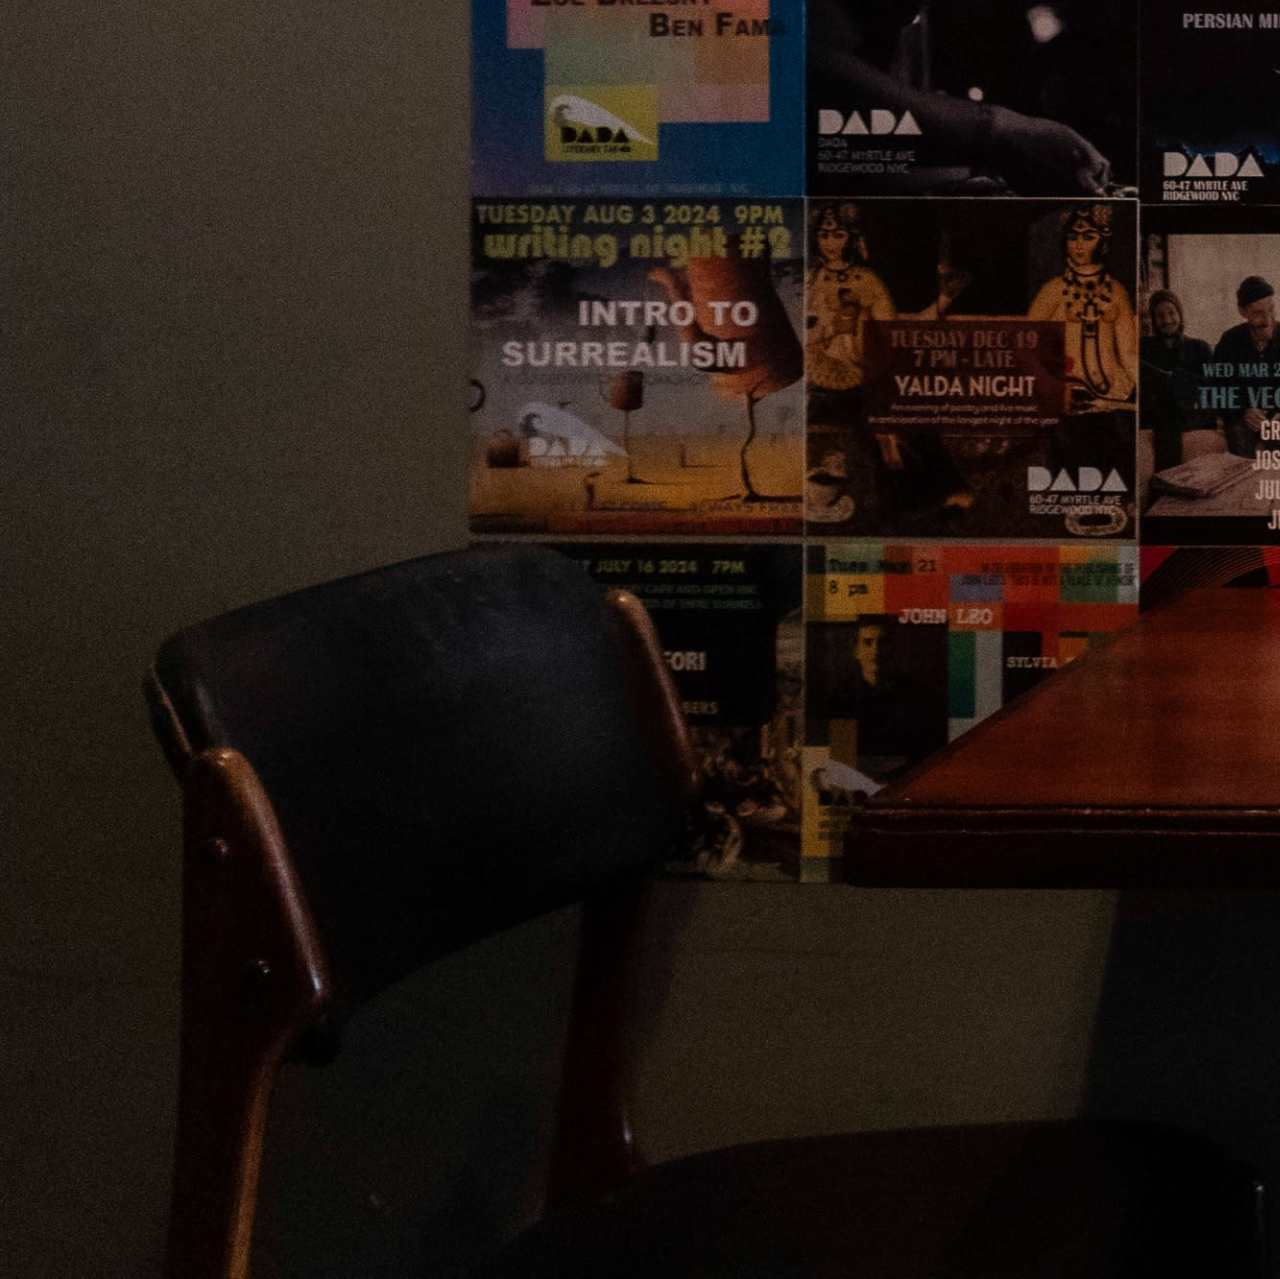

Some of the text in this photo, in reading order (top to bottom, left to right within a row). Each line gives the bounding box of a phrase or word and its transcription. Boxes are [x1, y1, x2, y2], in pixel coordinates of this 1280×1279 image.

[1182, 13, 1254, 30] PERSIAN
[579, 301, 757, 327] INTRO TO
[502, 342, 747, 368] SURREALISM
